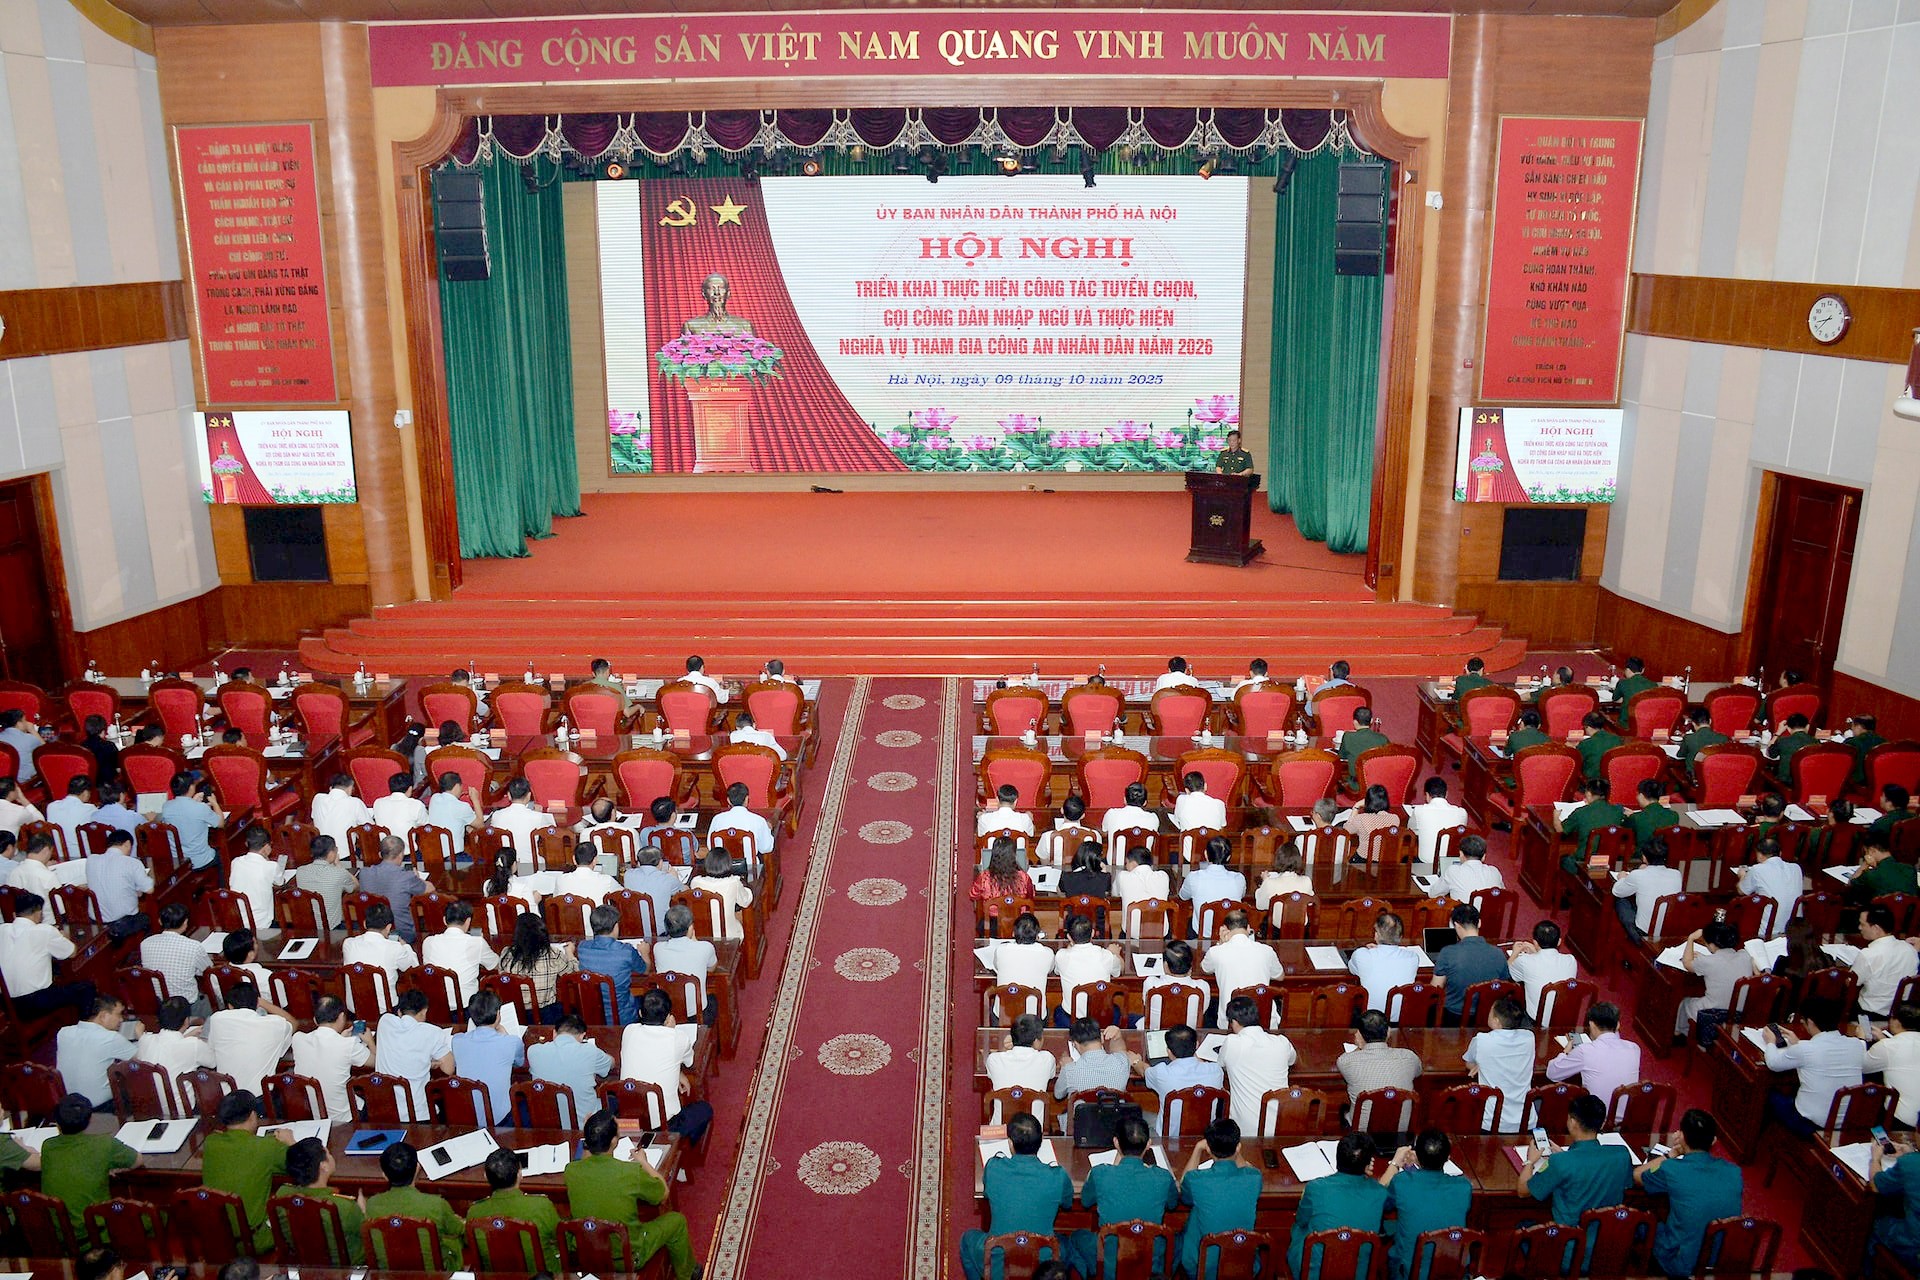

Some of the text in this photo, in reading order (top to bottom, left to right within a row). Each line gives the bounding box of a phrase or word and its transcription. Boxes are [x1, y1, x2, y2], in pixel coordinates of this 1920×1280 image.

[431, 22, 1387, 73] ĐẢNG CỘNG SẢN VIỆT NAM QUANG VINH MUÔN NĂM
[876, 203, 1177, 223] ỦY BAN NHÂN DÂN THÀNH PHỐ HÀ NỘI
[919, 231, 1134, 268] HỘI NGHỊ
[855, 273, 1198, 301] TRIỂN KHAI THỰC HIỆN CÔNG TÁC TUYỂN CHỌN,
[883, 309, 908, 331] GỌI
[913, 305, 953, 326] CÔNG
[958, 305, 989, 326] DÂN
[993, 305, 1034, 330] NHẬP
[1074, 305, 1093, 326] VÀ
[1097, 307, 1134, 330] THỰC
[1140, 305, 1174, 331] HIỆN
[839, 335, 1213, 358] NGHĨA VỤ THAM GIA CÔNG AN NHÂN DÂN NĂM 2026
[888, 374, 909, 385] Hà
[951, 374, 989, 387] ngày
[995, 374, 1013, 385] 09
[1018, 374, 1064, 387] tháng
[1069, 375, 1085, 385] 10
[1090, 374, 1123, 385] năm
[1128, 375, 1163, 385] 2025
[272, 428, 324, 440] HỘI NGHỊ
[1540, 426, 1594, 438] HỘI NGHỊ
